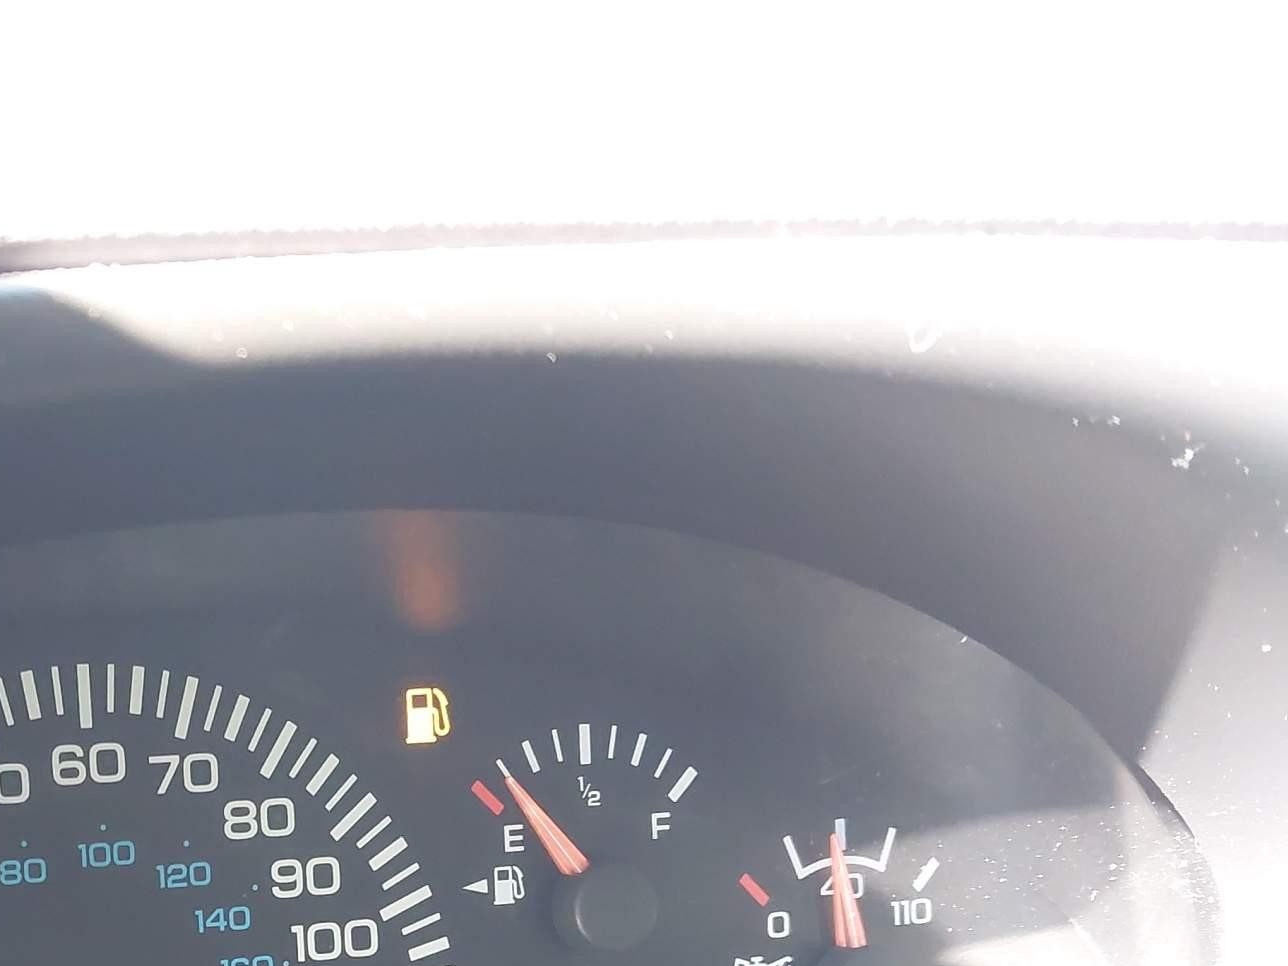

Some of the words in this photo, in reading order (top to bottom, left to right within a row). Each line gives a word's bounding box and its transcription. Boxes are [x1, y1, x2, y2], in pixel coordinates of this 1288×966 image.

[51, 741, 127, 786] 60
[147, 752, 220, 795] 70
[222, 797, 296, 840] 80
[651, 812, 671, 840] F
[503, 824, 525, 853] E
[77, 840, 136, 868] 100
[0, 858, 48, 885] 80
[155, 861, 212, 889] 120
[270, 856, 342, 899] 90
[194, 906, 251, 933] 140
[767, 911, 790, 938] 0
[890, 899, 933, 926] 110
[290, 918, 379, 963] 100
